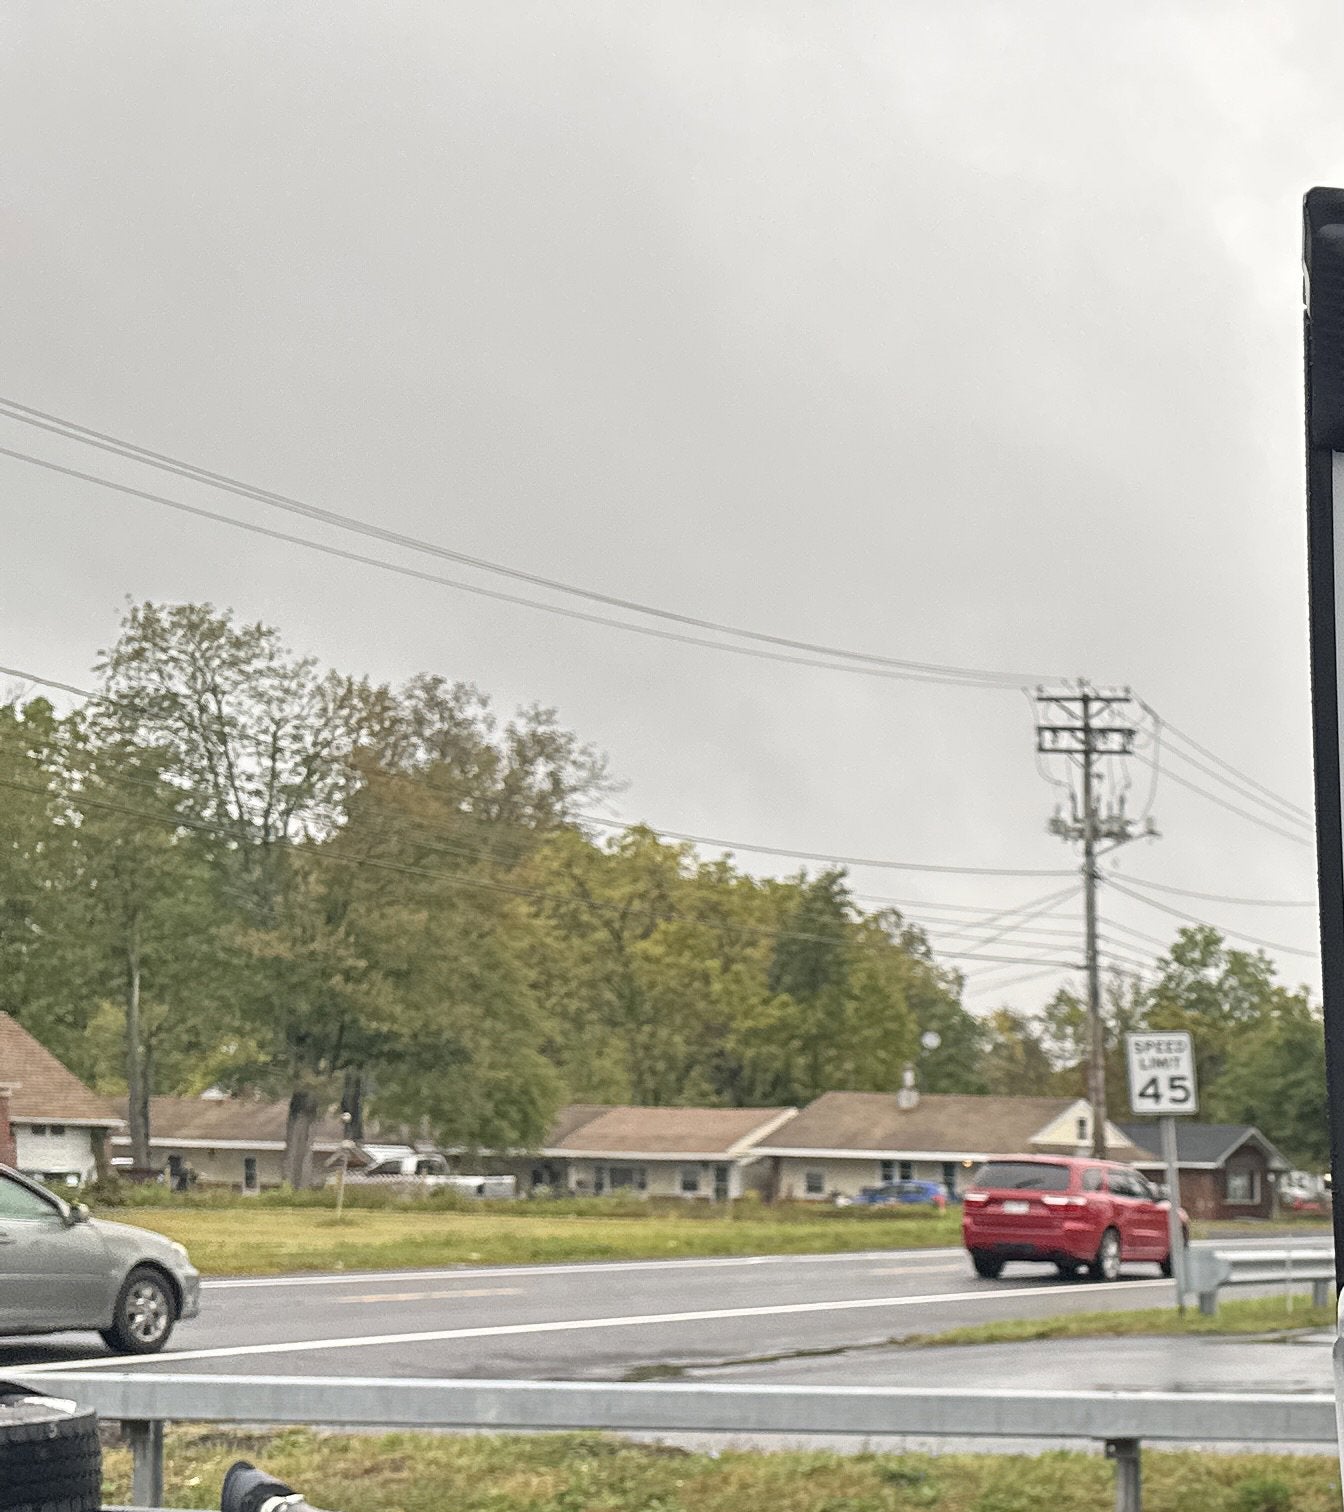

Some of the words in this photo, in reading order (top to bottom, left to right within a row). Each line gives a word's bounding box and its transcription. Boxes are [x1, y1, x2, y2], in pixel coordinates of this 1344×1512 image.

[1134, 1040, 1188, 1054] SPEED
[1138, 1055, 1181, 1070] LIMIT
[1138, 1075, 1191, 1105] 45
